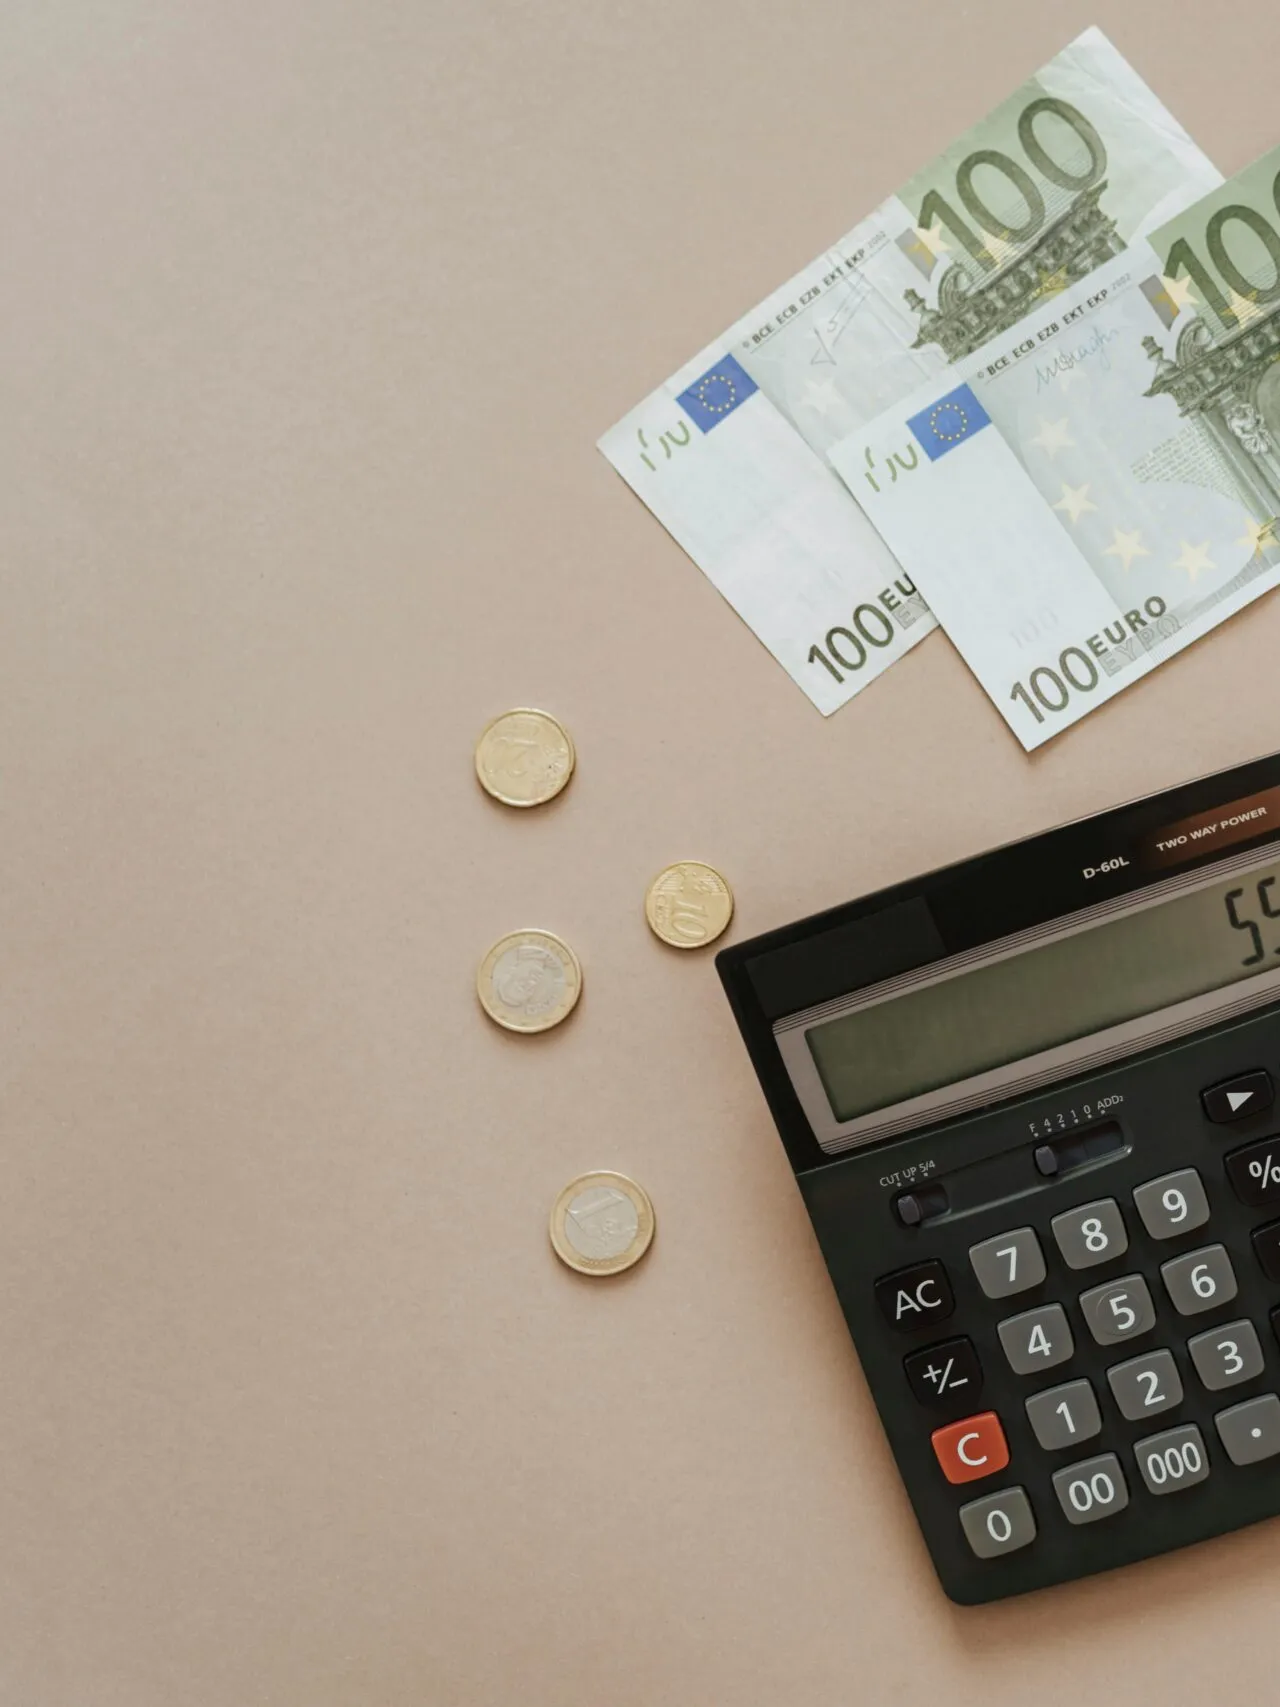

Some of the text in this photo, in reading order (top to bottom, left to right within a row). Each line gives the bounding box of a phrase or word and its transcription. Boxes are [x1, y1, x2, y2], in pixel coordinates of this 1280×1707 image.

[918, 97, 1108, 272] 100
[752, 323, 775, 345] BCE
[776, 304, 798, 325] ECB
[799, 285, 821, 305] EZB
[823, 266, 844, 287] EKT
[845, 248, 866, 268] EKP
[986, 355, 1011, 376] BCE
[1012, 339, 1036, 358] ECB
[1037, 322, 1060, 342] EZB
[1062, 305, 1085, 325] EKT
[1087, 288, 1109, 309] EKP
[808, 572, 917, 684] 100 EU
[1010, 595, 1167, 724] 100 EURO
[1156, 806, 1268, 852] TWO WAY POWER
[1082, 856, 1130, 880] D-60L
[1029, 1123, 1037, 1133] F
[1043, 1118, 1051, 1128] 4
[1057, 1113, 1065, 1124] 2
[1070, 1109, 1078, 1119] 1
[1083, 1104, 1092, 1115] 0
[879, 1160, 936, 1188] CUT UP 5/4
[1163, 1189, 1187, 1222] 9
[1082, 1219, 1107, 1251] 8
[997, 1247, 1016, 1281] 7
[1192, 1265, 1215, 1297] 6
[897, 1280, 941, 1319] AC
[1110, 1295, 1135, 1329] 5
[1029, 1325, 1051, 1355] 4
[1218, 1342, 1243, 1374] 3
[1137, 1372, 1165, 1405] 2
[1056, 1402, 1075, 1432] 1
[958, 1433, 987, 1465] C
[1148, 1443, 1201, 1482] 000
[1069, 1473, 1114, 1511] 00
[988, 1511, 1011, 1541] 0
